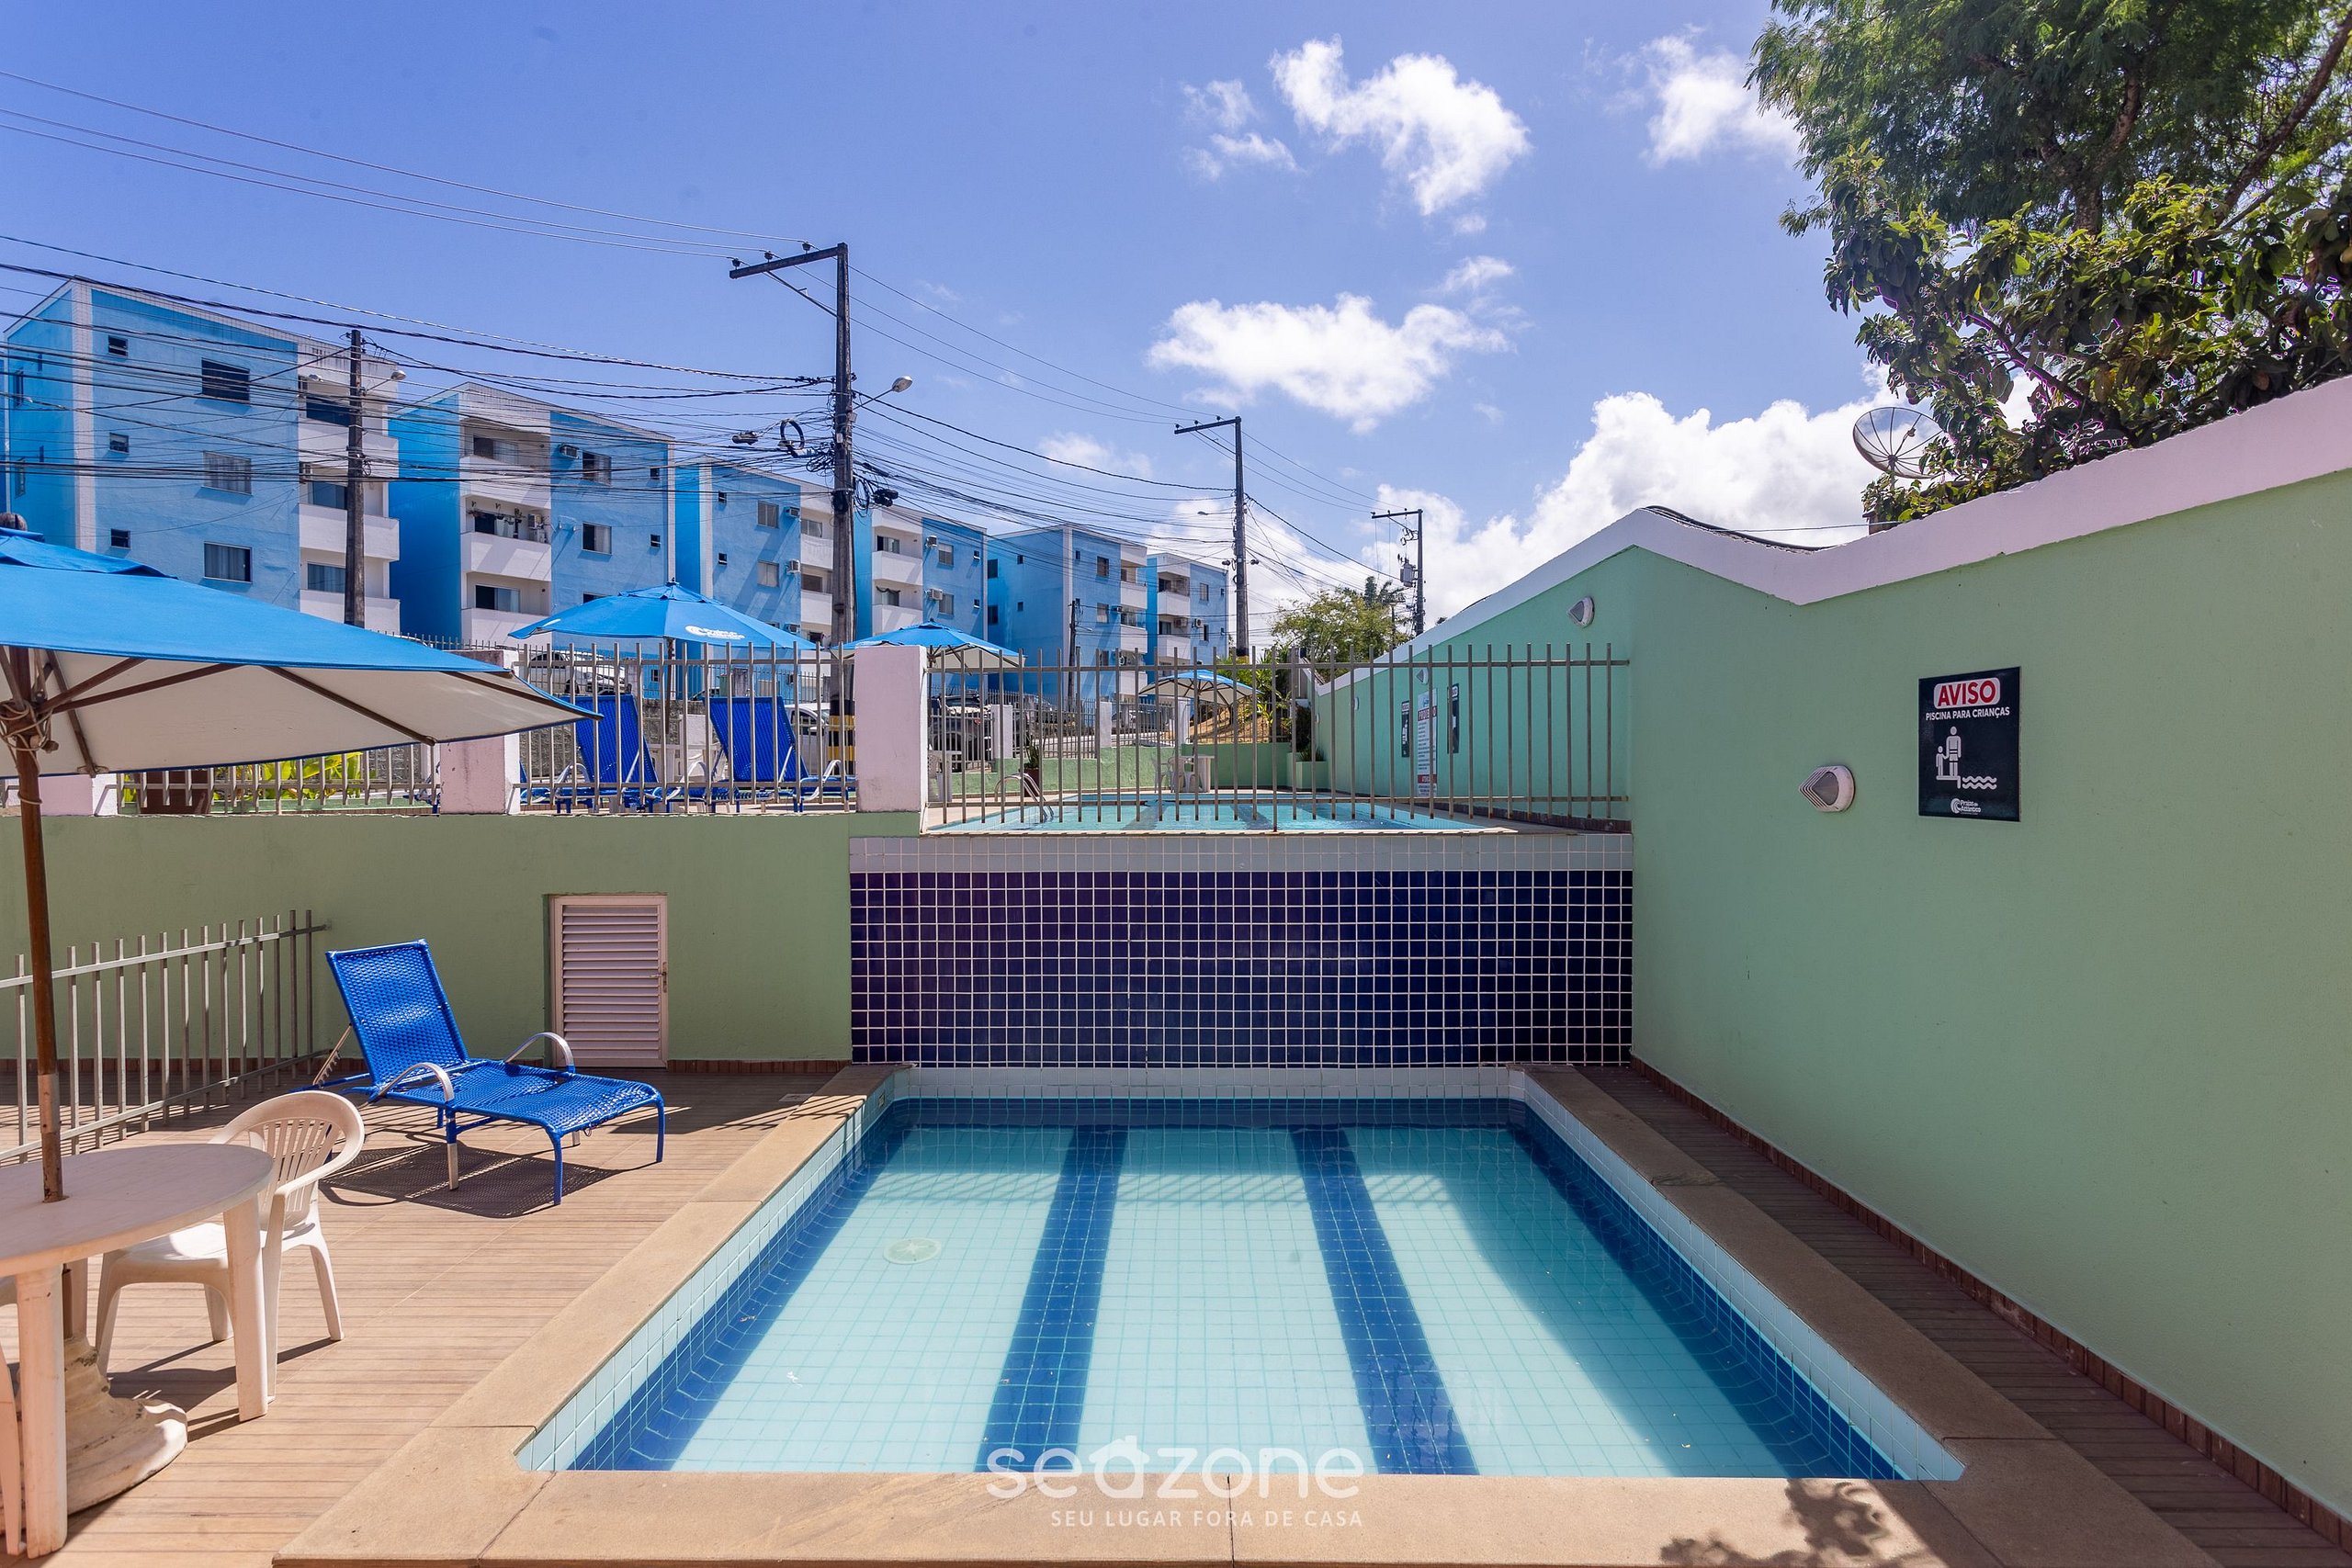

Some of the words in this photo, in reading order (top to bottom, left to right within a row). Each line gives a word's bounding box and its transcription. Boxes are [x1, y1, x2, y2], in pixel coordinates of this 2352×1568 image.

[1938, 680, 1996, 706] AVISO
[1925, 711, 1951, 721] PISCINA
[1952, 709, 1971, 719] PARA
[1972, 706, 2010, 718] CRIANÇAS
